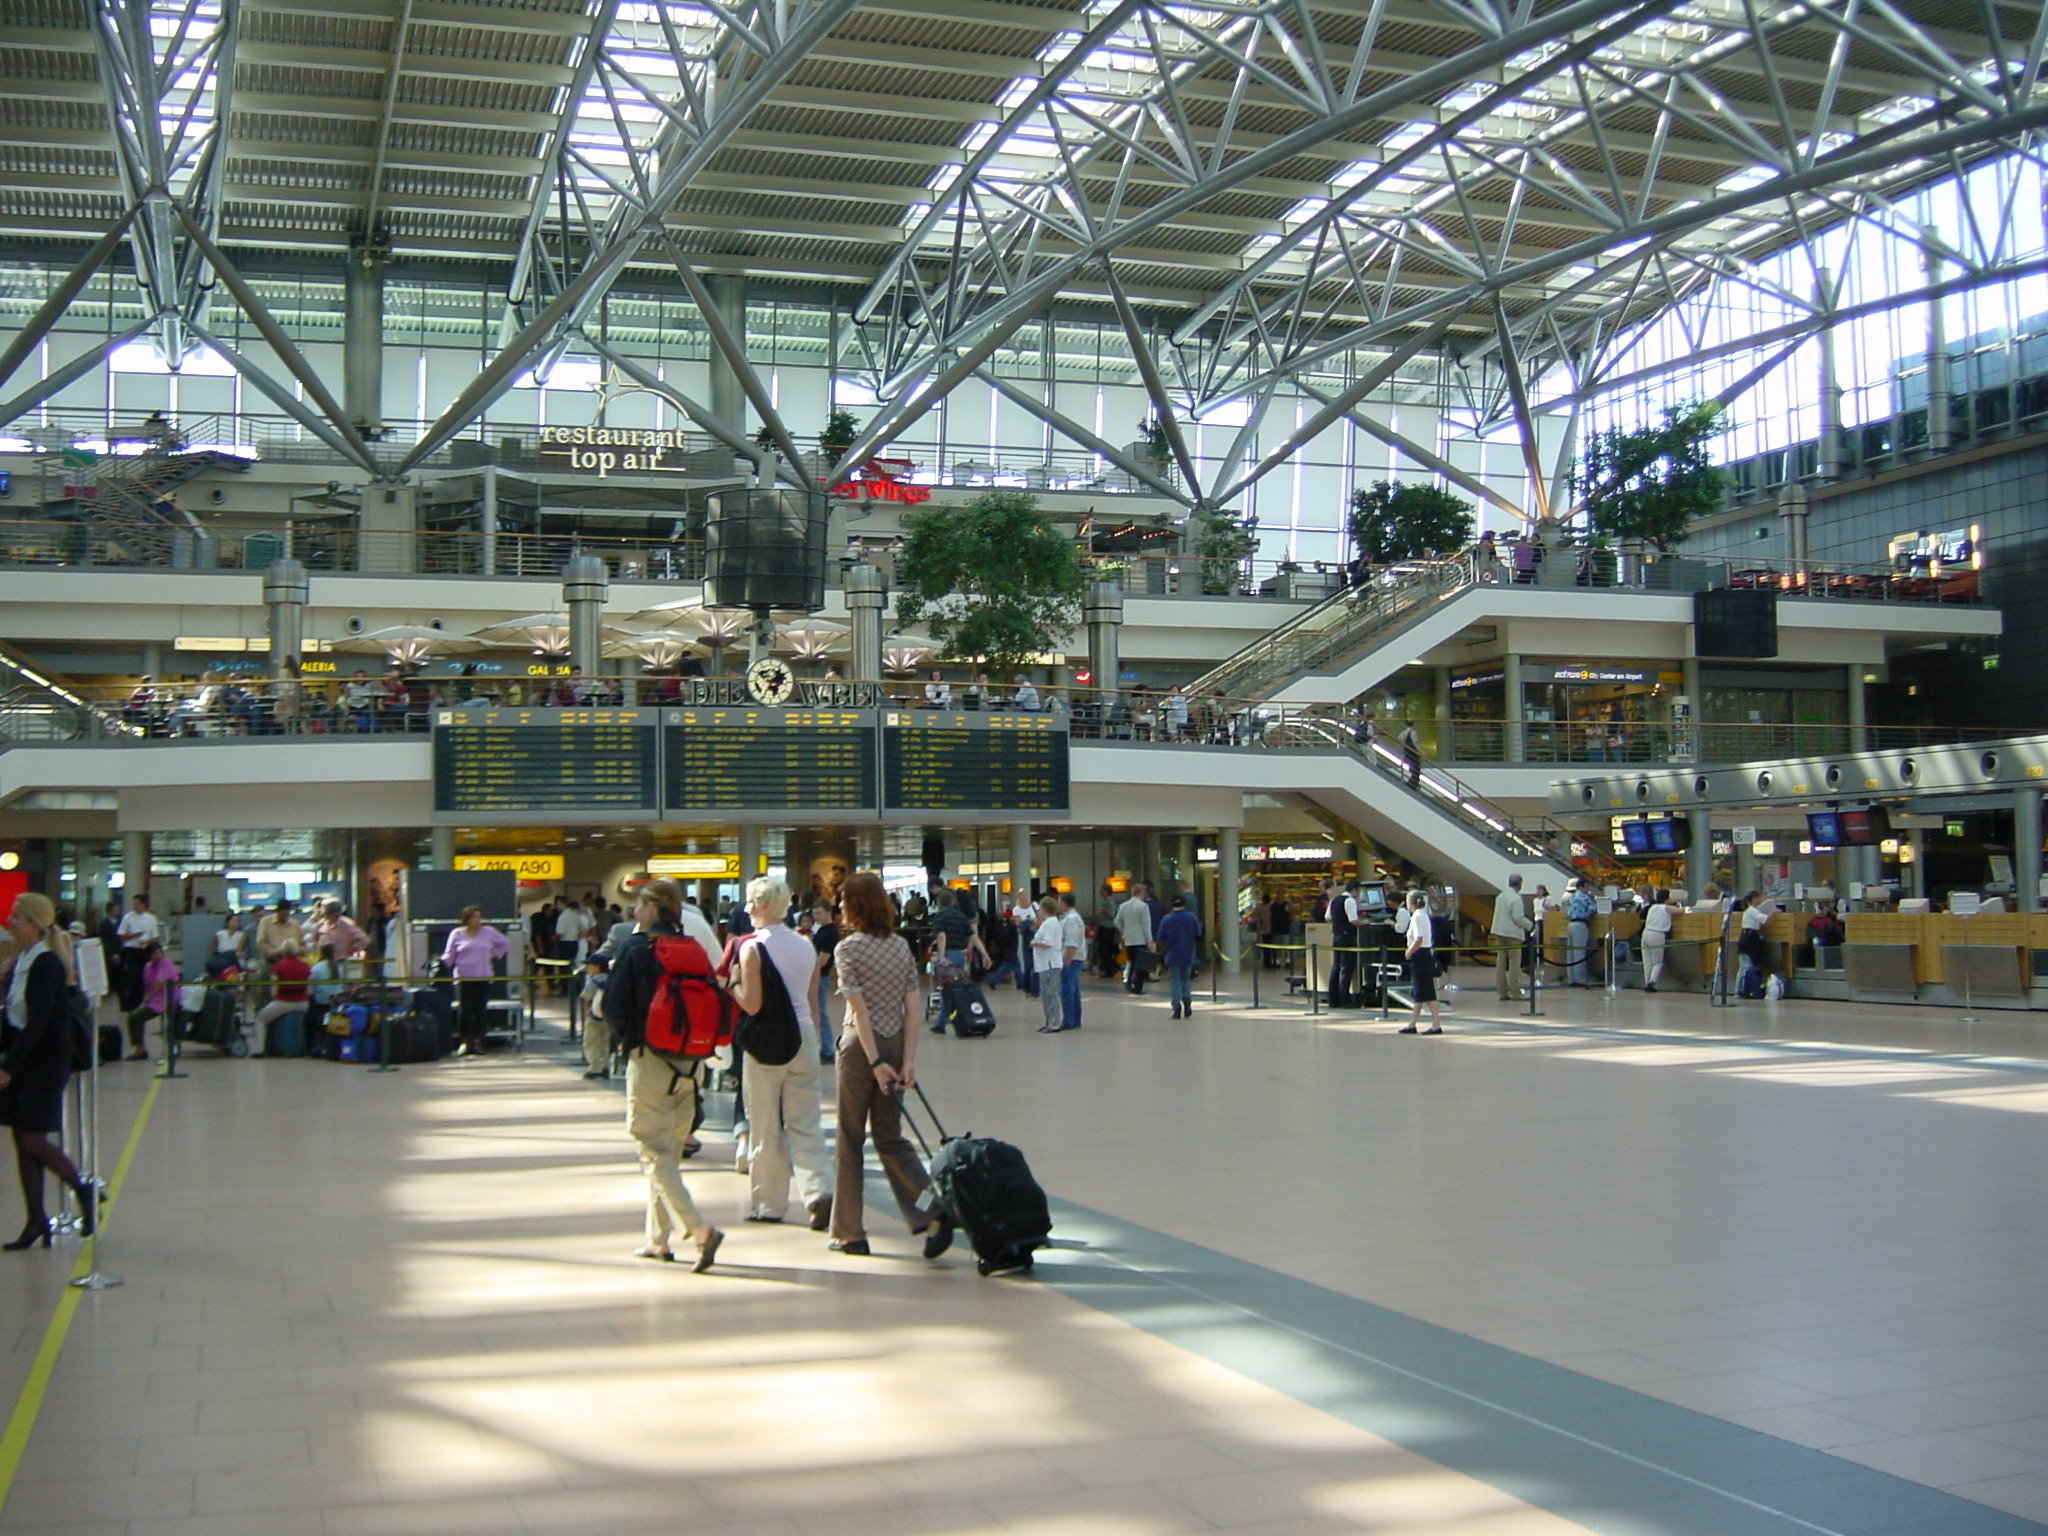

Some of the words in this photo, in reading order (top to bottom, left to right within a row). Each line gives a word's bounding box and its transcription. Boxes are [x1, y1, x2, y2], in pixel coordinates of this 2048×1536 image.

[543, 425, 685, 448] restaurant
[571, 446, 616, 478] top
[623, 447, 663, 470] air
[863, 480, 932, 504] Wings
[300, 661, 337, 672] ALERIA
[690, 681, 744, 706] DIE
[798, 682, 883, 707] WELT
[518, 861, 551, 874] A90
[728, 860, 740, 872] 2
